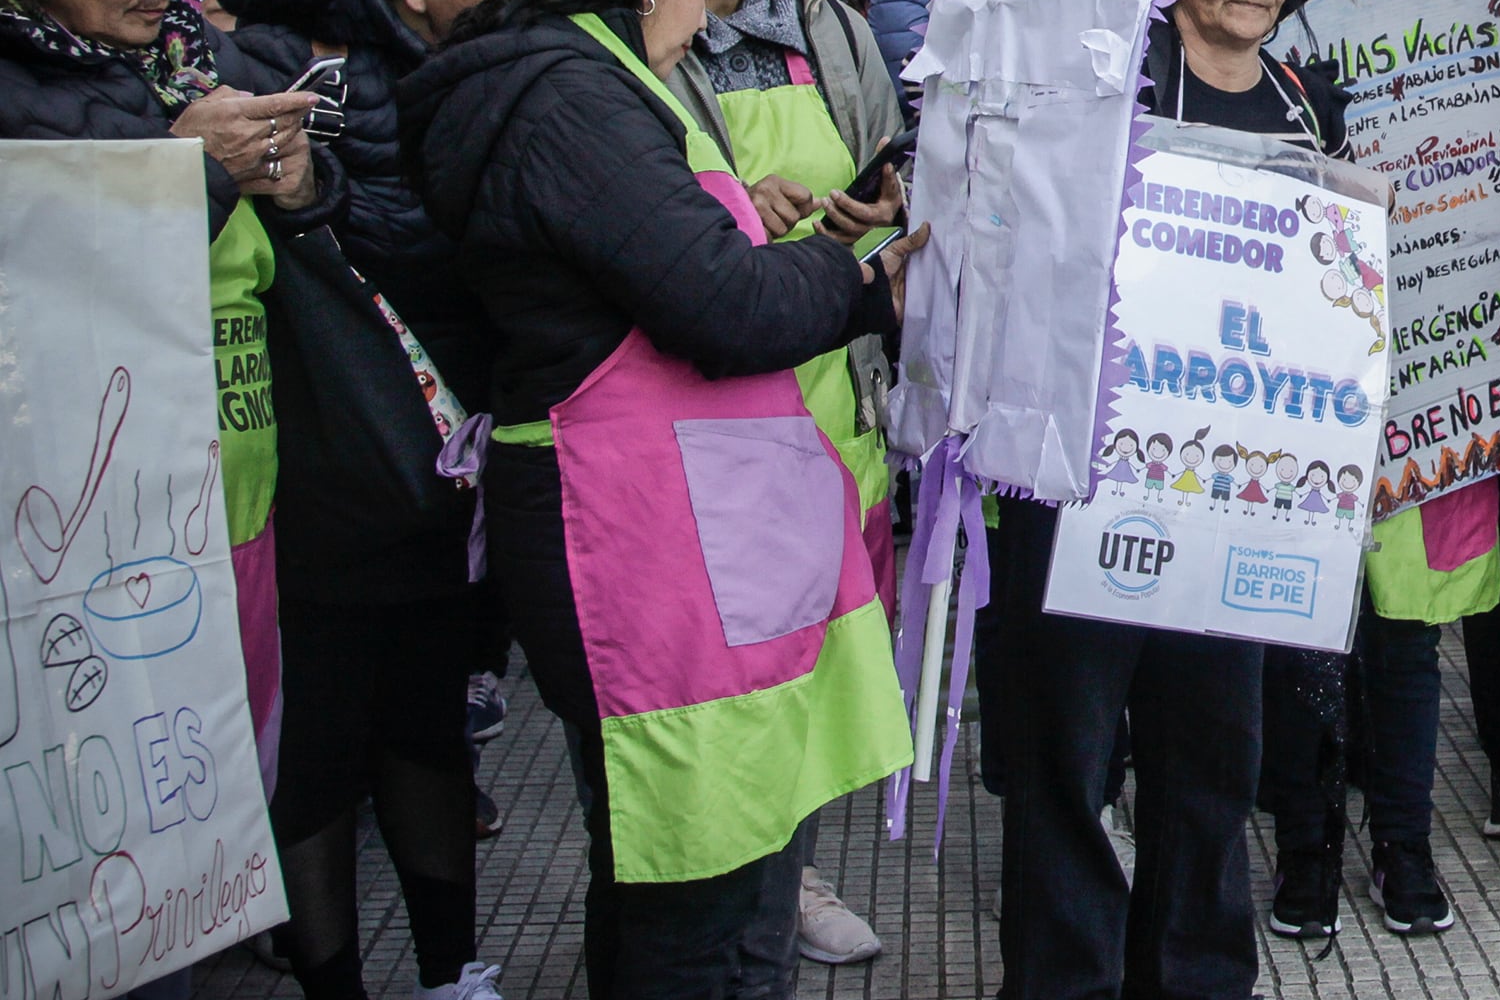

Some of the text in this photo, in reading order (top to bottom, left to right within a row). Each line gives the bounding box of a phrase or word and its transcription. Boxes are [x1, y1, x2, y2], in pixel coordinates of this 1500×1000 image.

[1447, 62, 1467, 80] EL
[1348, 116, 1380, 137] ENTE
[1388, 112, 1398, 125] A
[1131, 217, 1285, 275] COMEDOR
[1219, 299, 1272, 358] EL
[1121, 339, 1371, 428] ARROYITO
[1383, 404, 1448, 461] BRE
[1449, 386, 1483, 436] NO
[1098, 531, 1176, 577] UTEP
[1236, 561, 1307, 584] BARRIOS
[1233, 578, 1305, 605] DE PIE
[3, 706, 219, 884] NO ES
